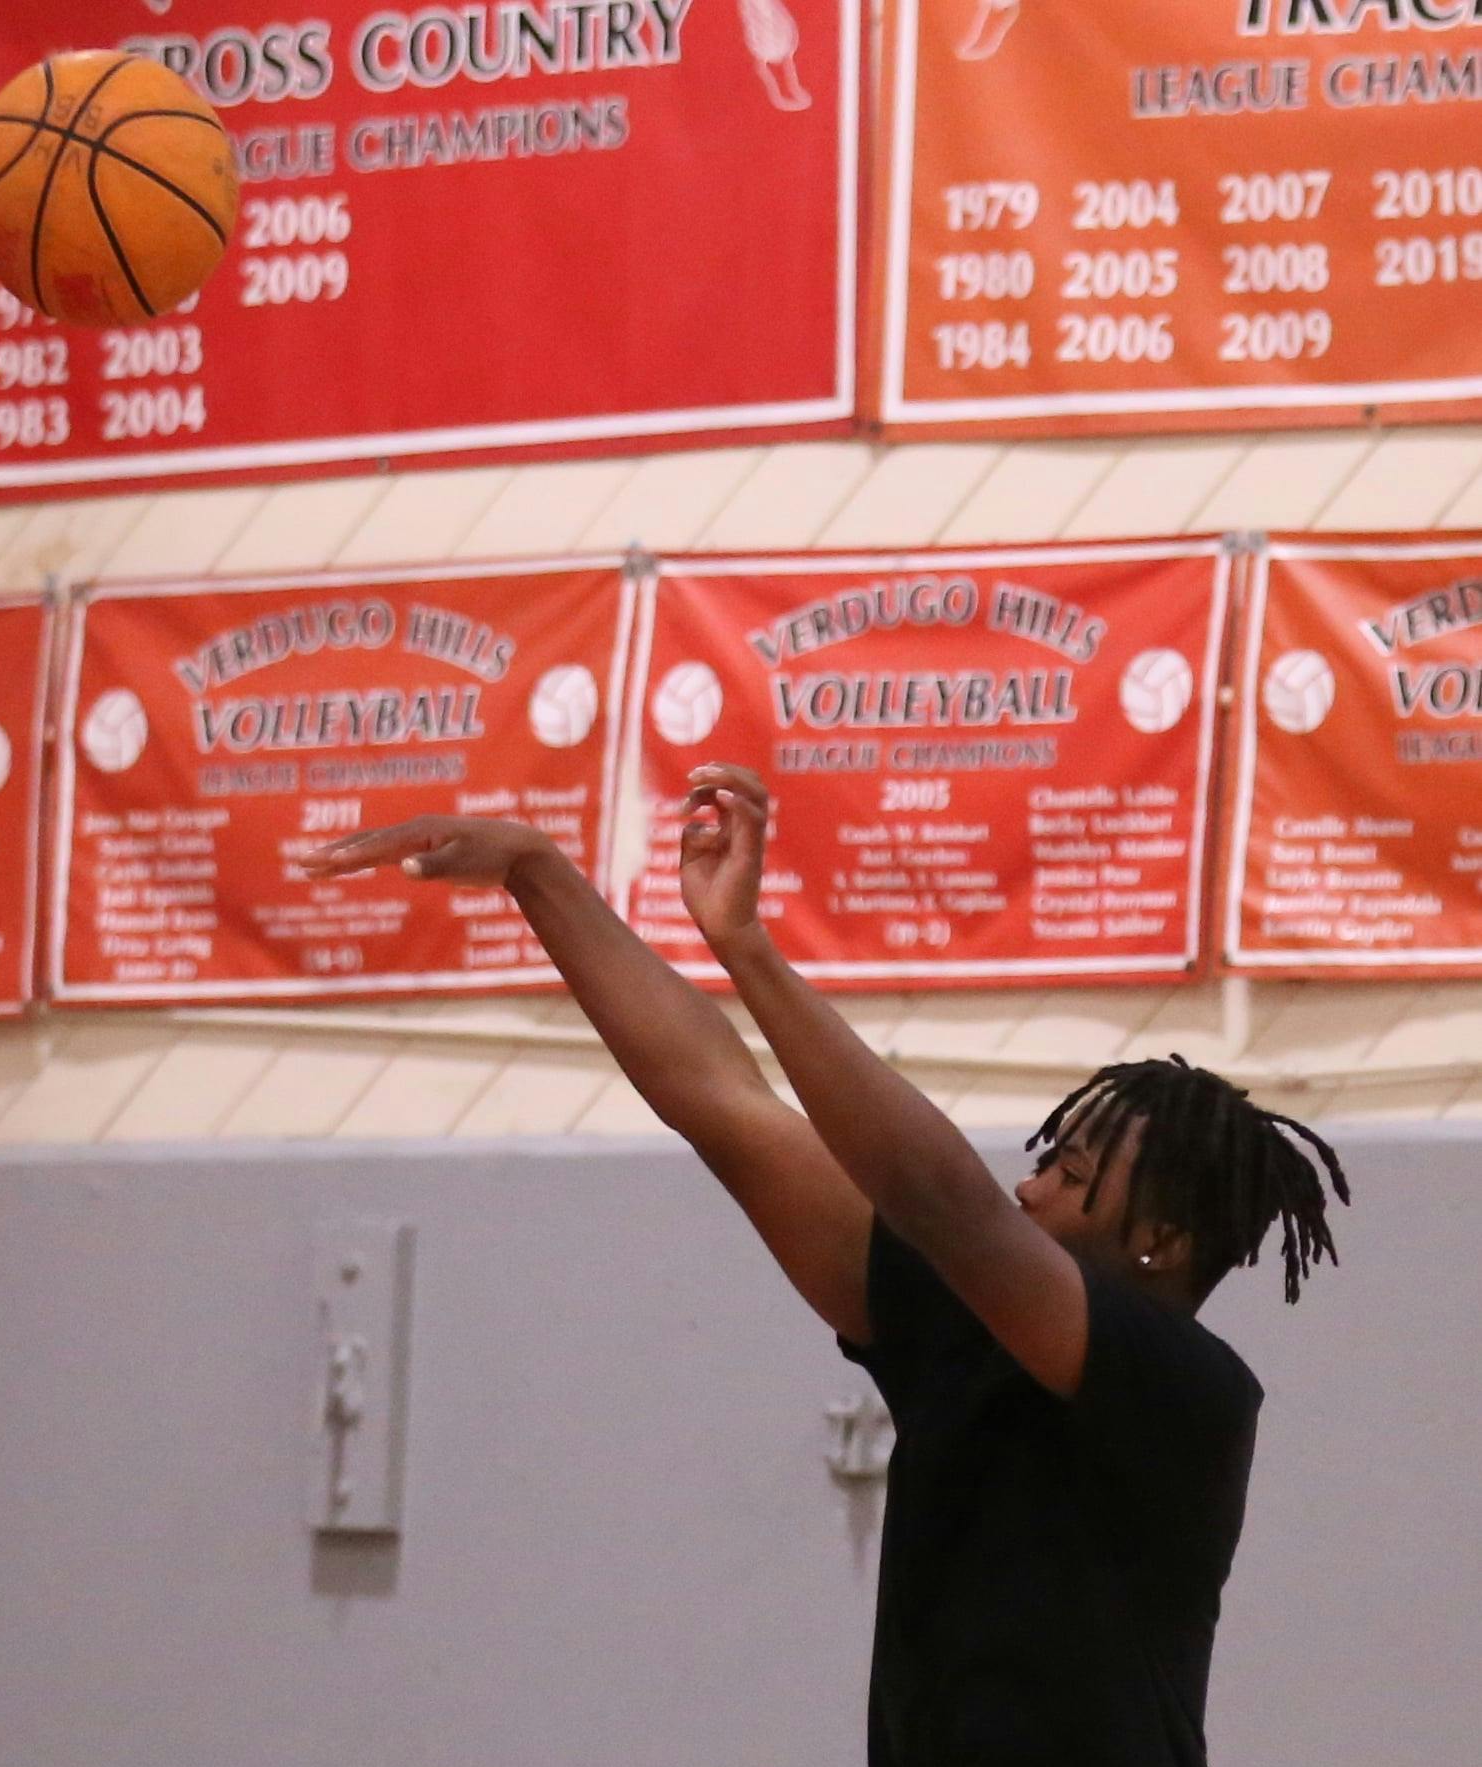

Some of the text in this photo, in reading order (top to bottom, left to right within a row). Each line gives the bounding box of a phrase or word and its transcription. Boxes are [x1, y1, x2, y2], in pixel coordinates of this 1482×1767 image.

[120, 0, 696, 107] ROSS COUNTRY
[1130, 58, 1309, 118] LEAGUE
[347, 96, 630, 173] CHAMPIONS
[242, 193, 352, 250] 2006
[942, 180, 1039, 231] 1979
[1070, 178, 1179, 230] 2004
[1219, 169, 1332, 223] 2007
[240, 251, 350, 307] 2009
[935, 250, 1036, 300] 1980
[1062, 249, 1180, 300] 2005
[1222, 243, 1330, 295] 2008
[101, 323, 204, 380] 2003
[932, 310, 1332, 370] 1984 2006 2009
[101, 383, 208, 441] 2004
[172, 597, 517, 698] VERDUGO HILLS
[747, 575, 1108, 668] VERDUGO HILLS
[191, 683, 485, 756] VOLLEYBALL
[769, 667, 1079, 730] VOLLEYBALL
[304, 751, 466, 792] CHAMPIONS
[774, 736, 1059, 774] LEAGUE CHAMPIONS
[301, 799, 362, 833] 2011
